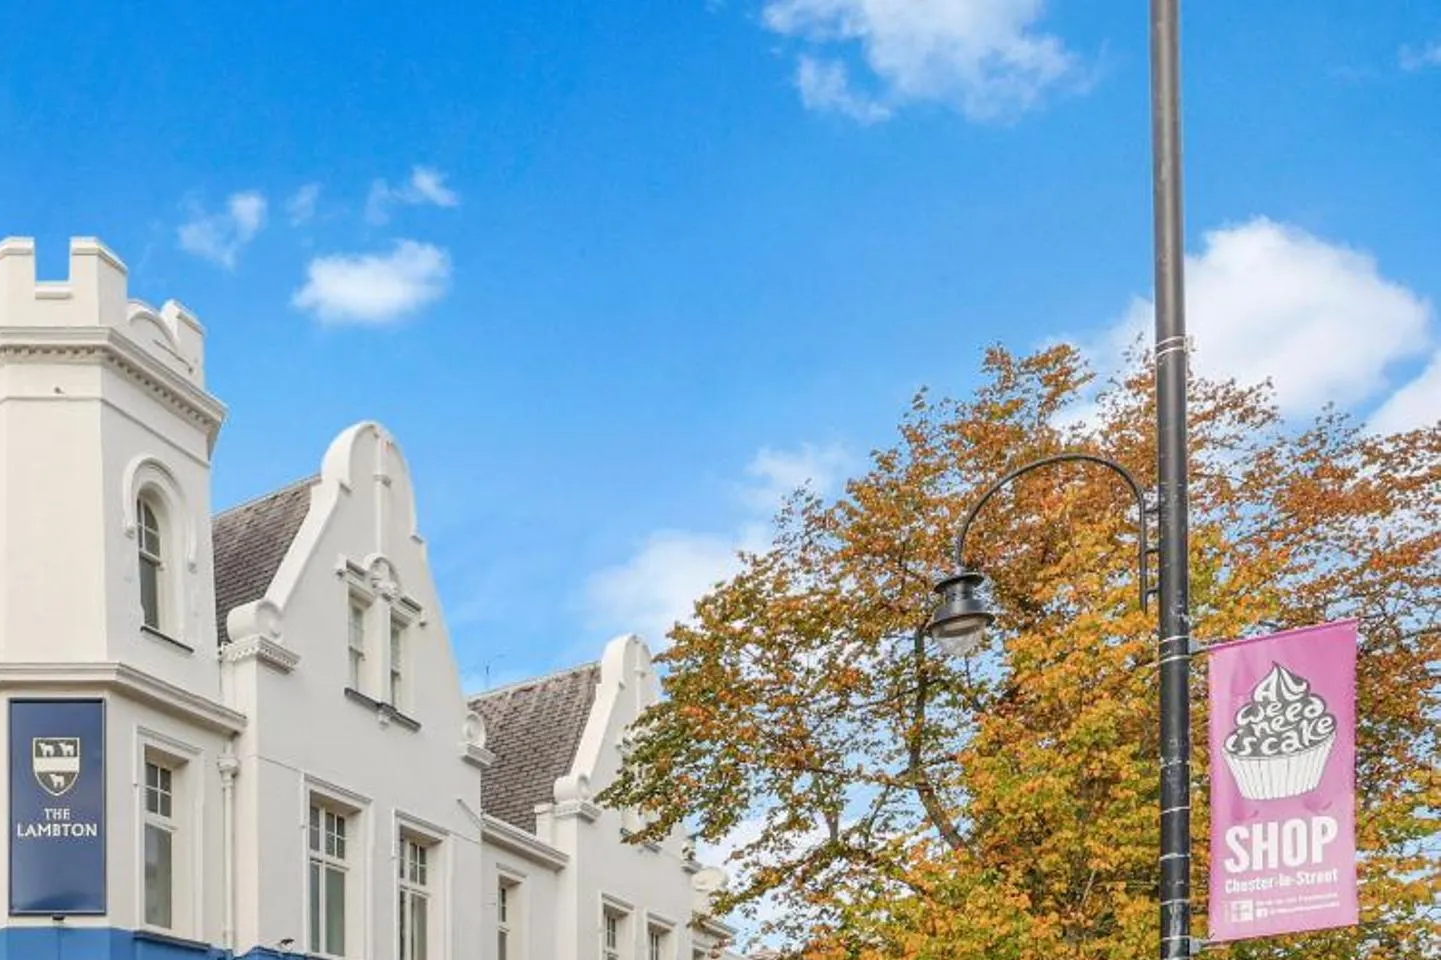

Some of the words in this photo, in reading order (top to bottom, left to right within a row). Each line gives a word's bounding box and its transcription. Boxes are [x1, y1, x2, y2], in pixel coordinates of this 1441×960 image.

[1250, 696, 1325, 738] need
[1225, 728, 1258, 756] is
[1260, 716, 1335, 756] cake
[16, 823, 98, 838] LAMBTON
[43, 808, 71, 821] THE
[1223, 816, 1338, 874] SHOP
